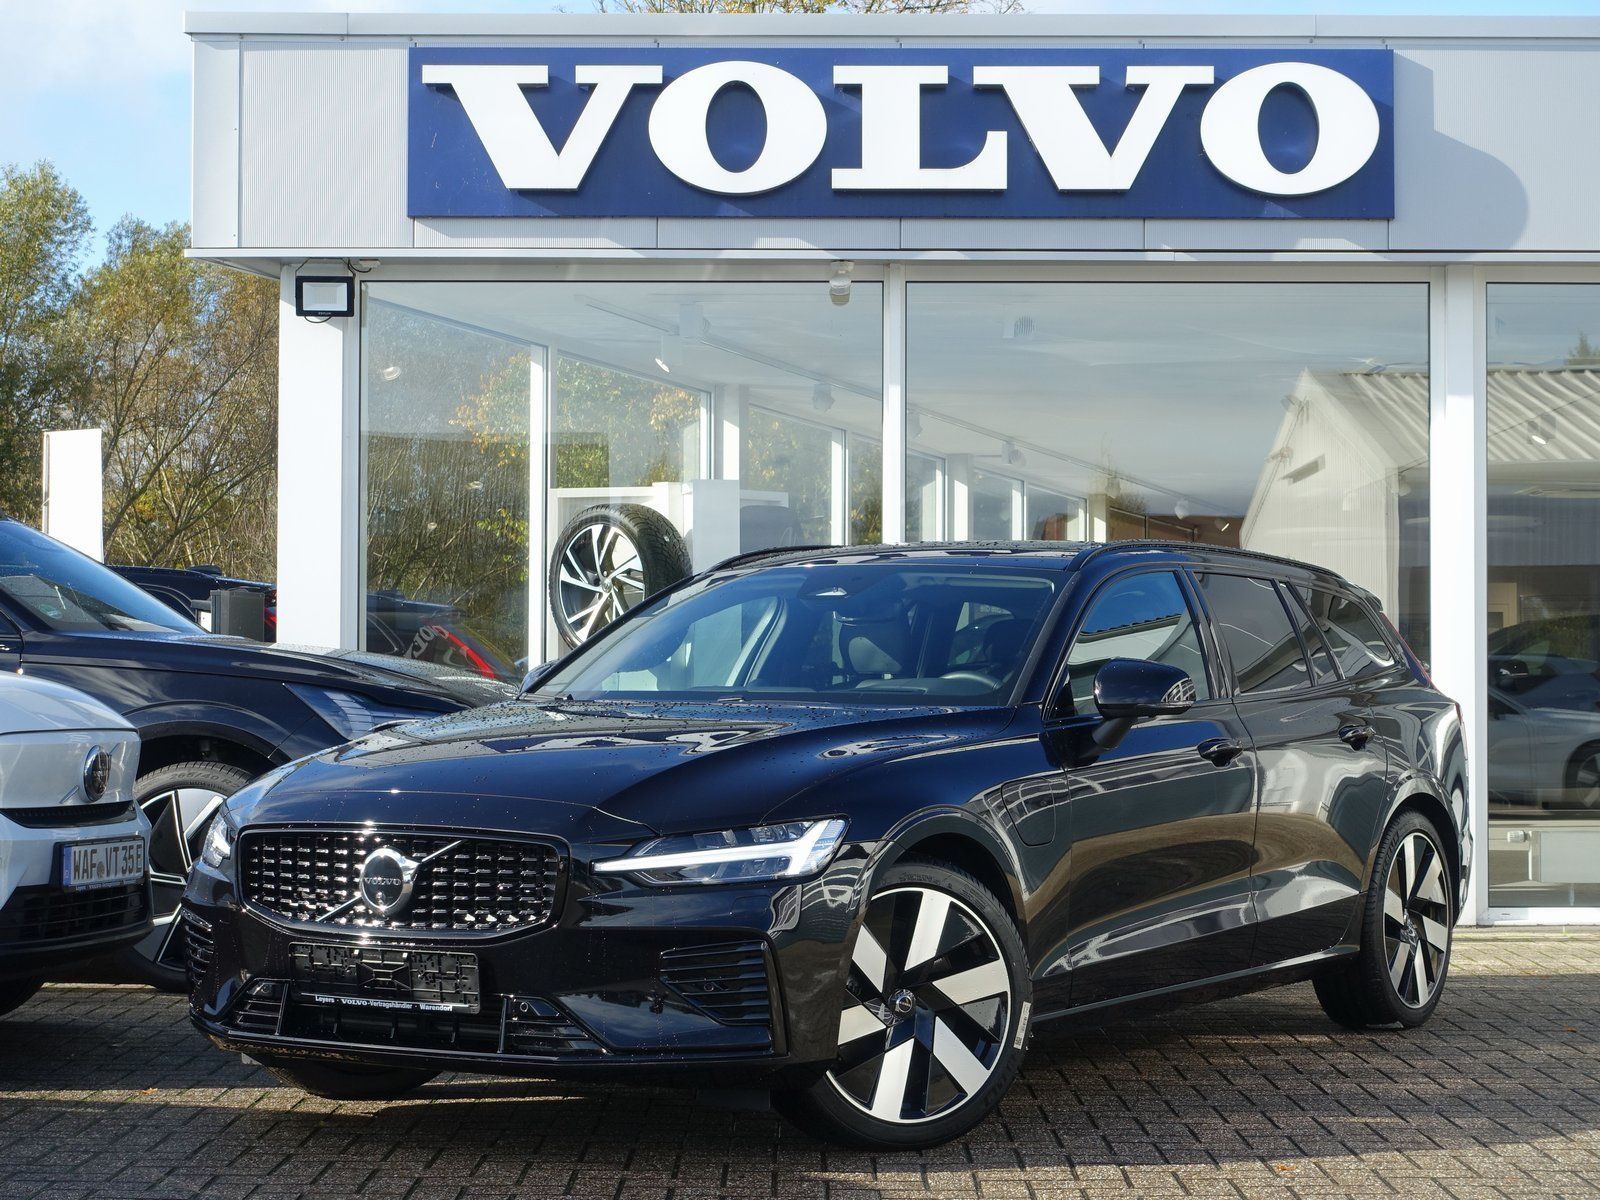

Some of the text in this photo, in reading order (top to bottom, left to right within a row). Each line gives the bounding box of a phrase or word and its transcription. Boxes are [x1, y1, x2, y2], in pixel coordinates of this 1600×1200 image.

[422, 61, 1380, 194] VOLVO
[73, 848, 97, 880] WAF
[105, 846, 119, 877] VT
[364, 876, 402, 886] VOLVO
[420, 1003, 453, 1011] Warendorf
